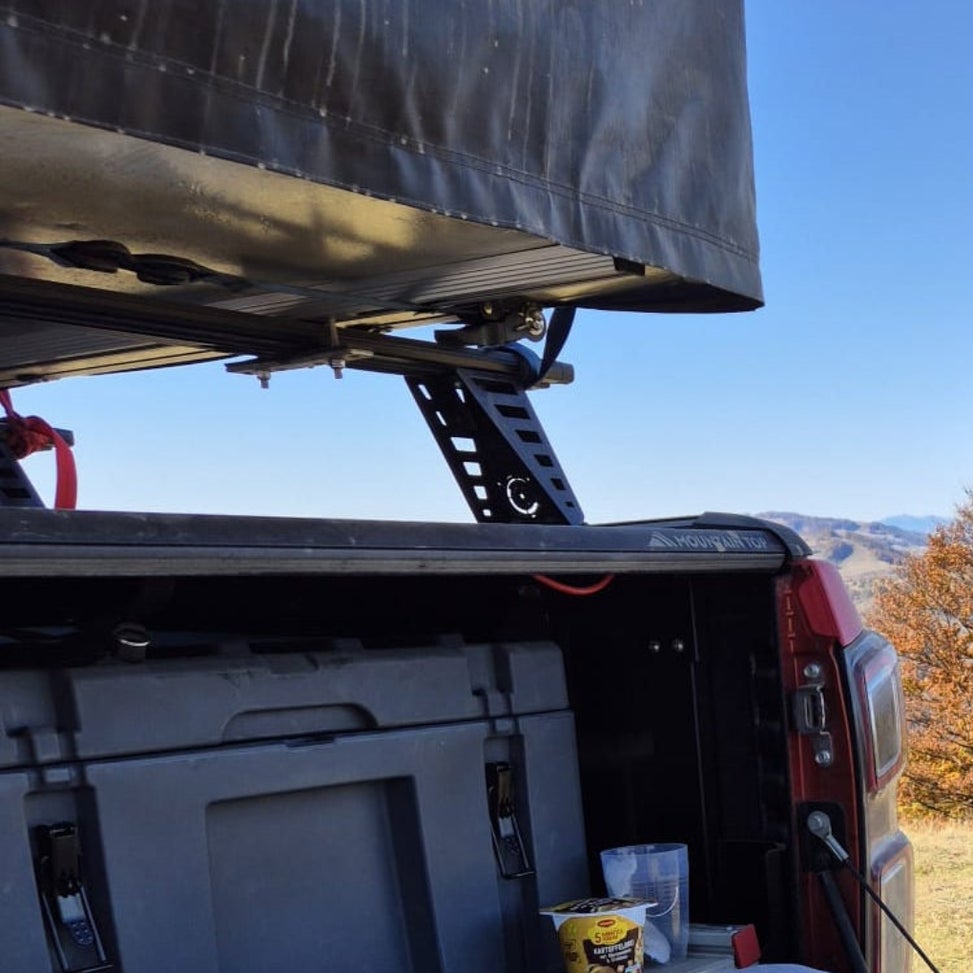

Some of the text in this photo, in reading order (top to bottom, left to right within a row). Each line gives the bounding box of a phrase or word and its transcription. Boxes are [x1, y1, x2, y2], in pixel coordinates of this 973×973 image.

[673, 534, 768, 550] MOUNTAIN TOP
[595, 932, 602, 944] 5
